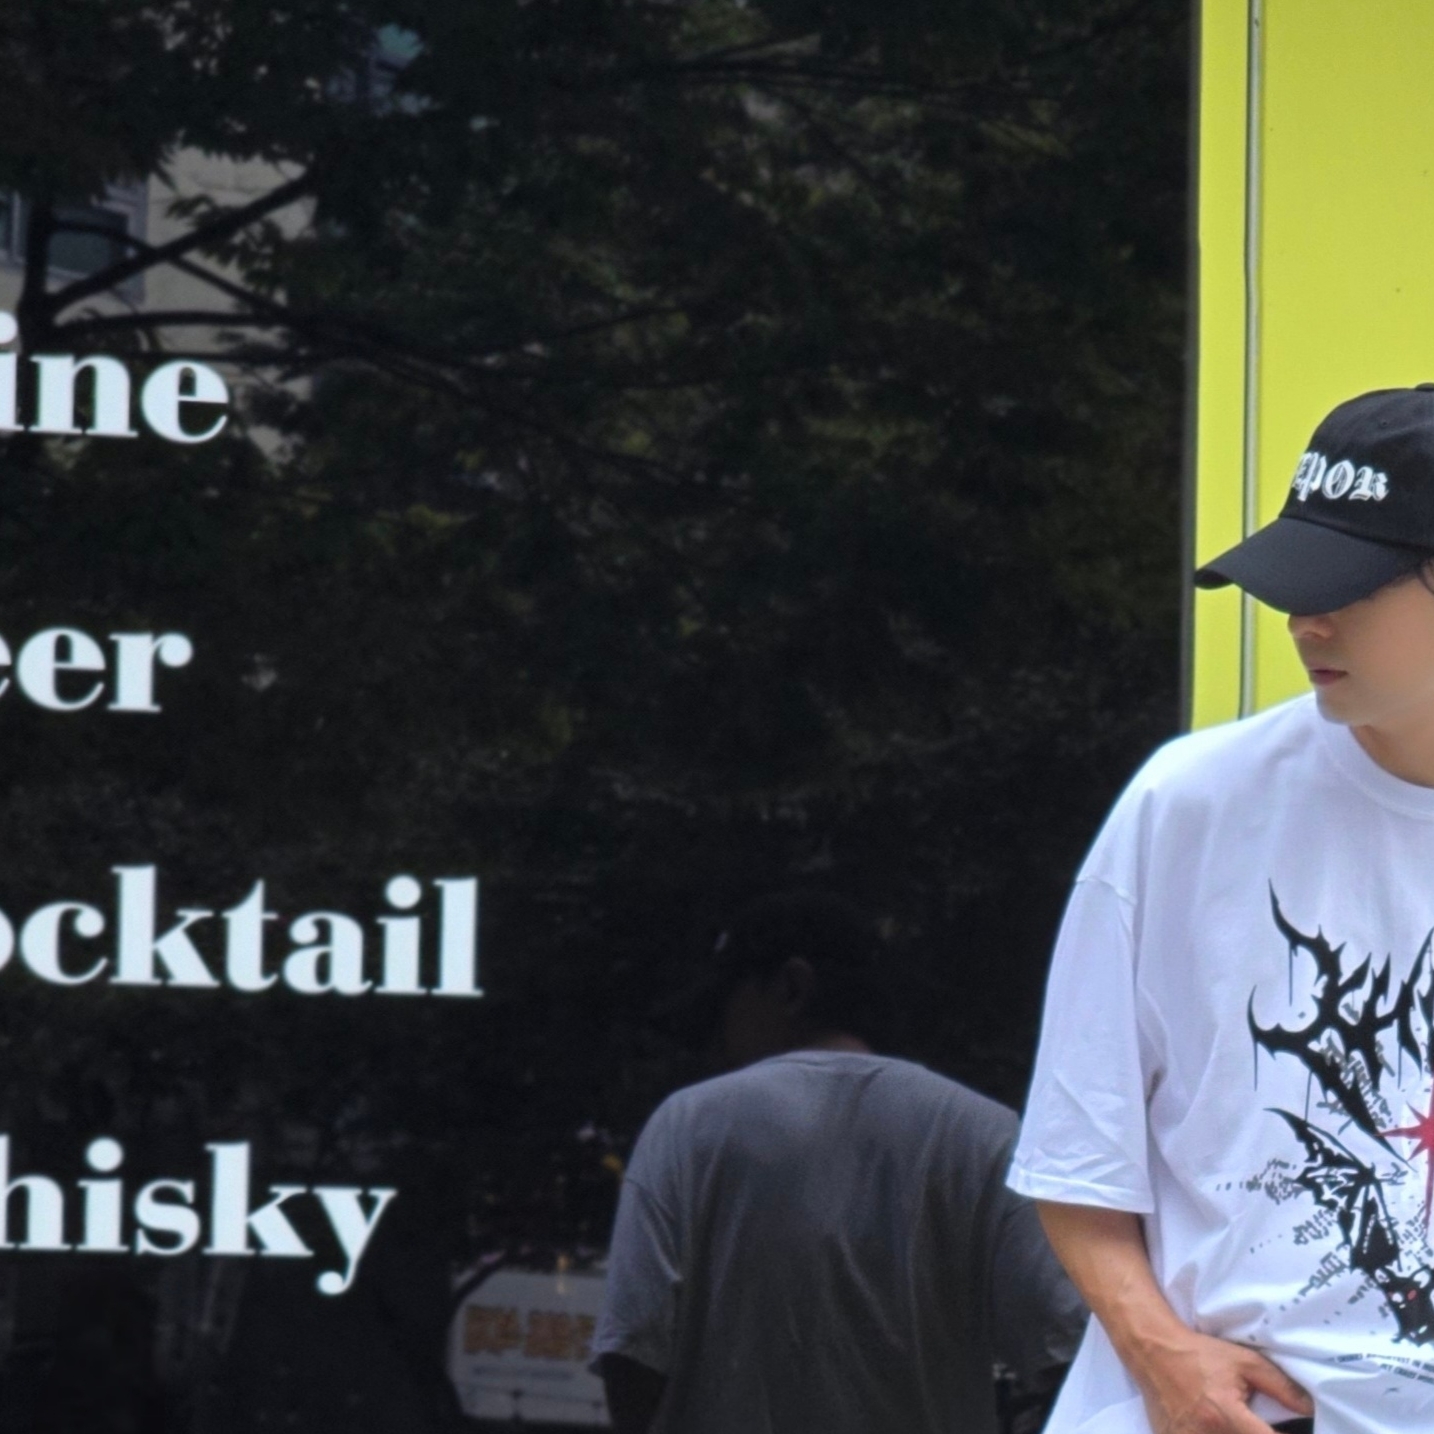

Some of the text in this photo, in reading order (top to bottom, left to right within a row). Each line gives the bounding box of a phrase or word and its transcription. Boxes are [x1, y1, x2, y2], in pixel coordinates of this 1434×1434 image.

[0, 627, 194, 713] er
[0, 864, 484, 997] cktail
[0, 1134, 397, 1296] hisky
